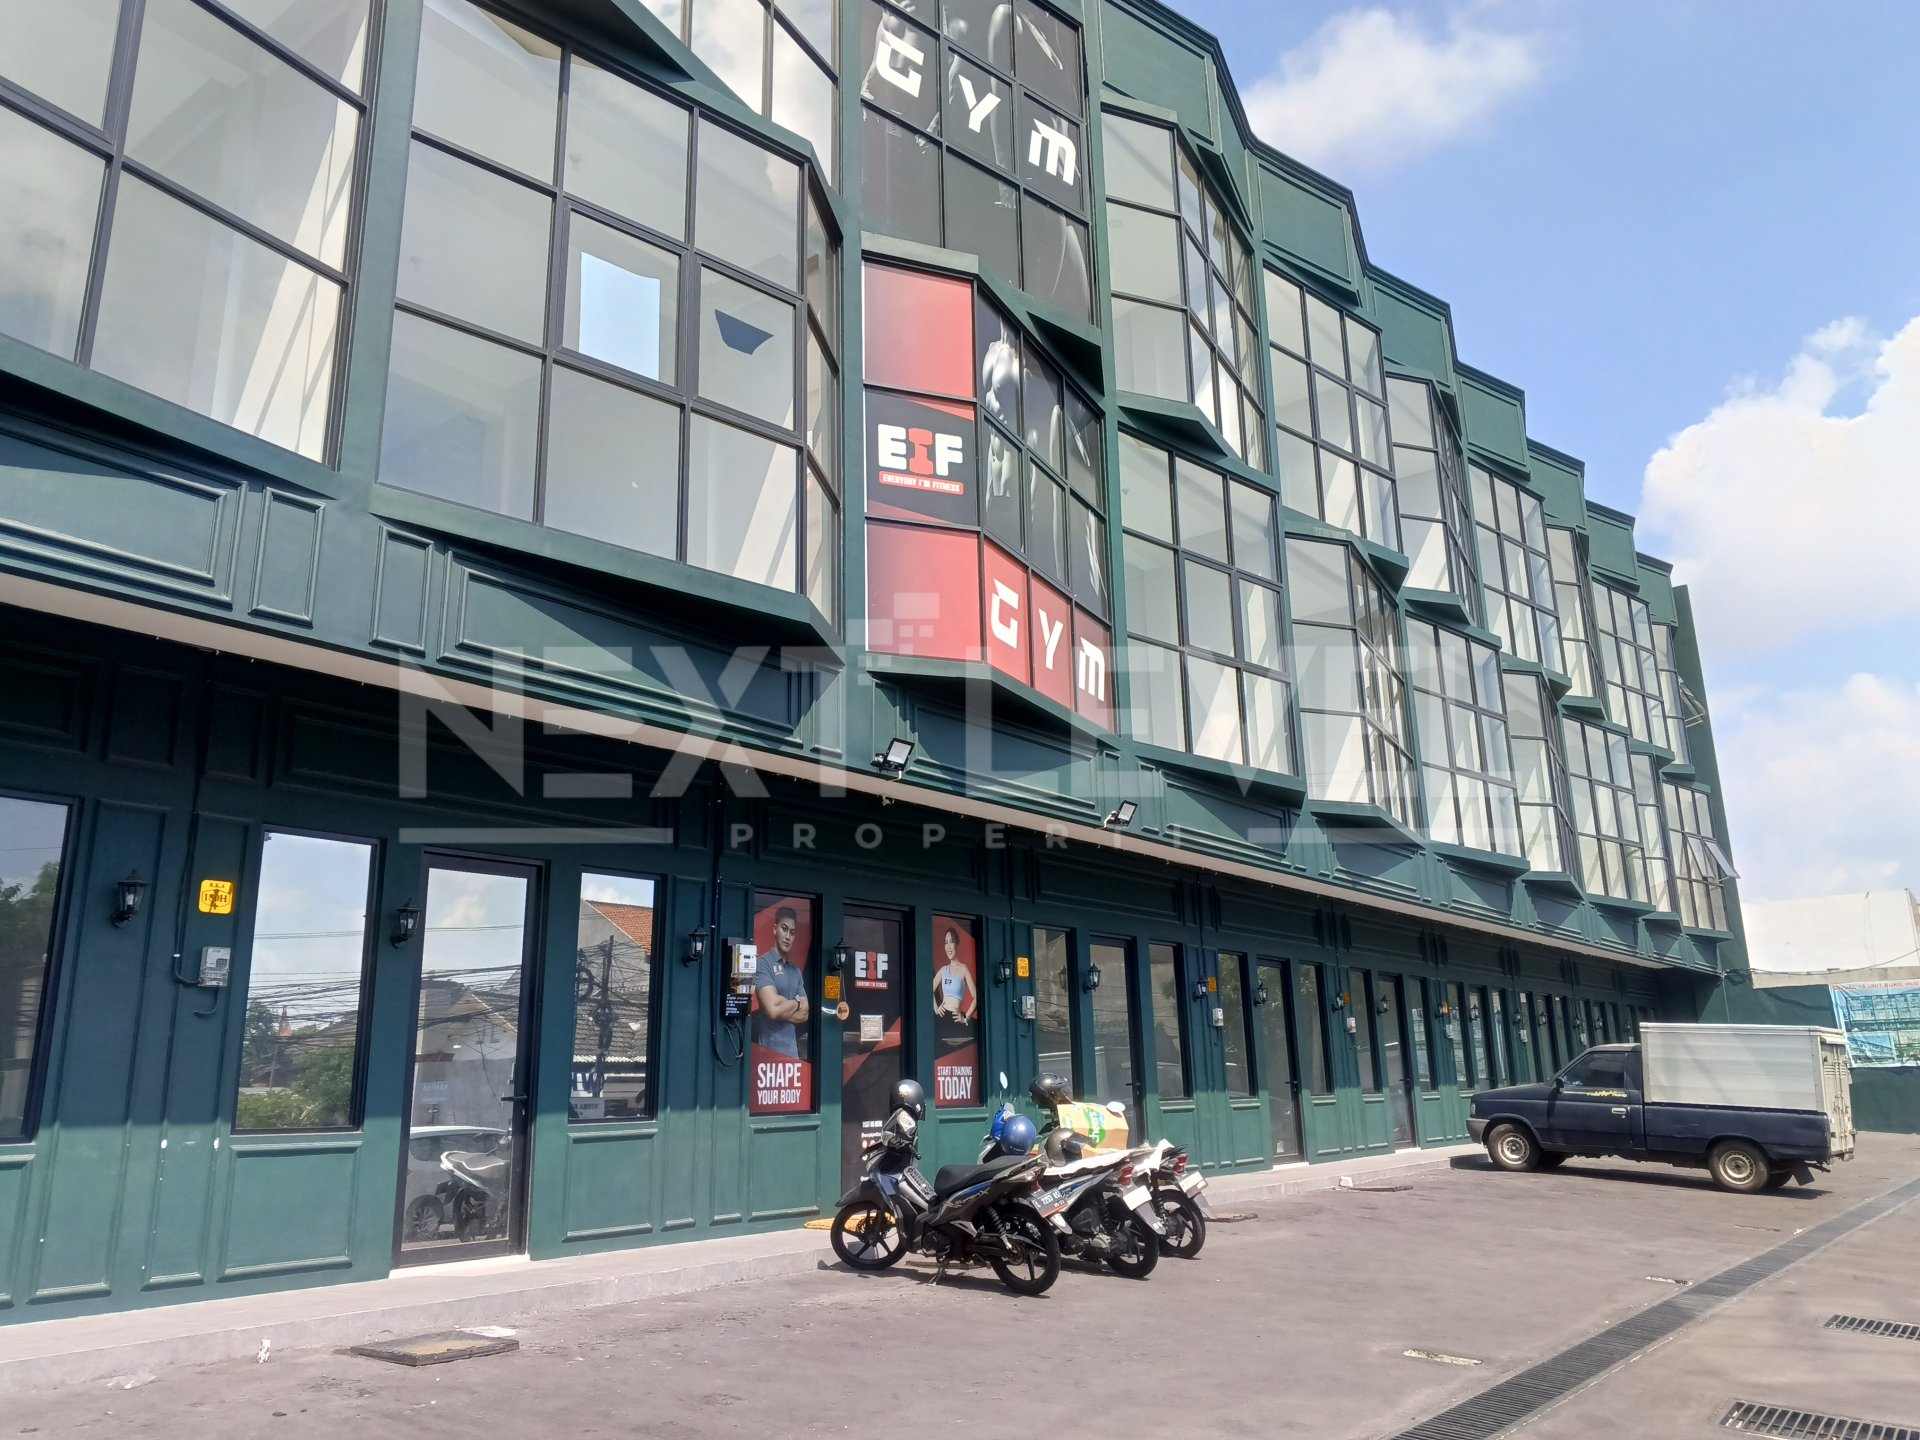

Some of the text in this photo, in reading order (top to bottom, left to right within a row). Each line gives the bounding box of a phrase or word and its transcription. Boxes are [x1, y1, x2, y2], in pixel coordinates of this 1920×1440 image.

[757, 1062, 802, 1089] SHAPE
[937, 1065, 973, 1076] START TRAINING
[757, 1088, 801, 1105] YOUR BODY
[937, 1076, 973, 1100] TODAY
